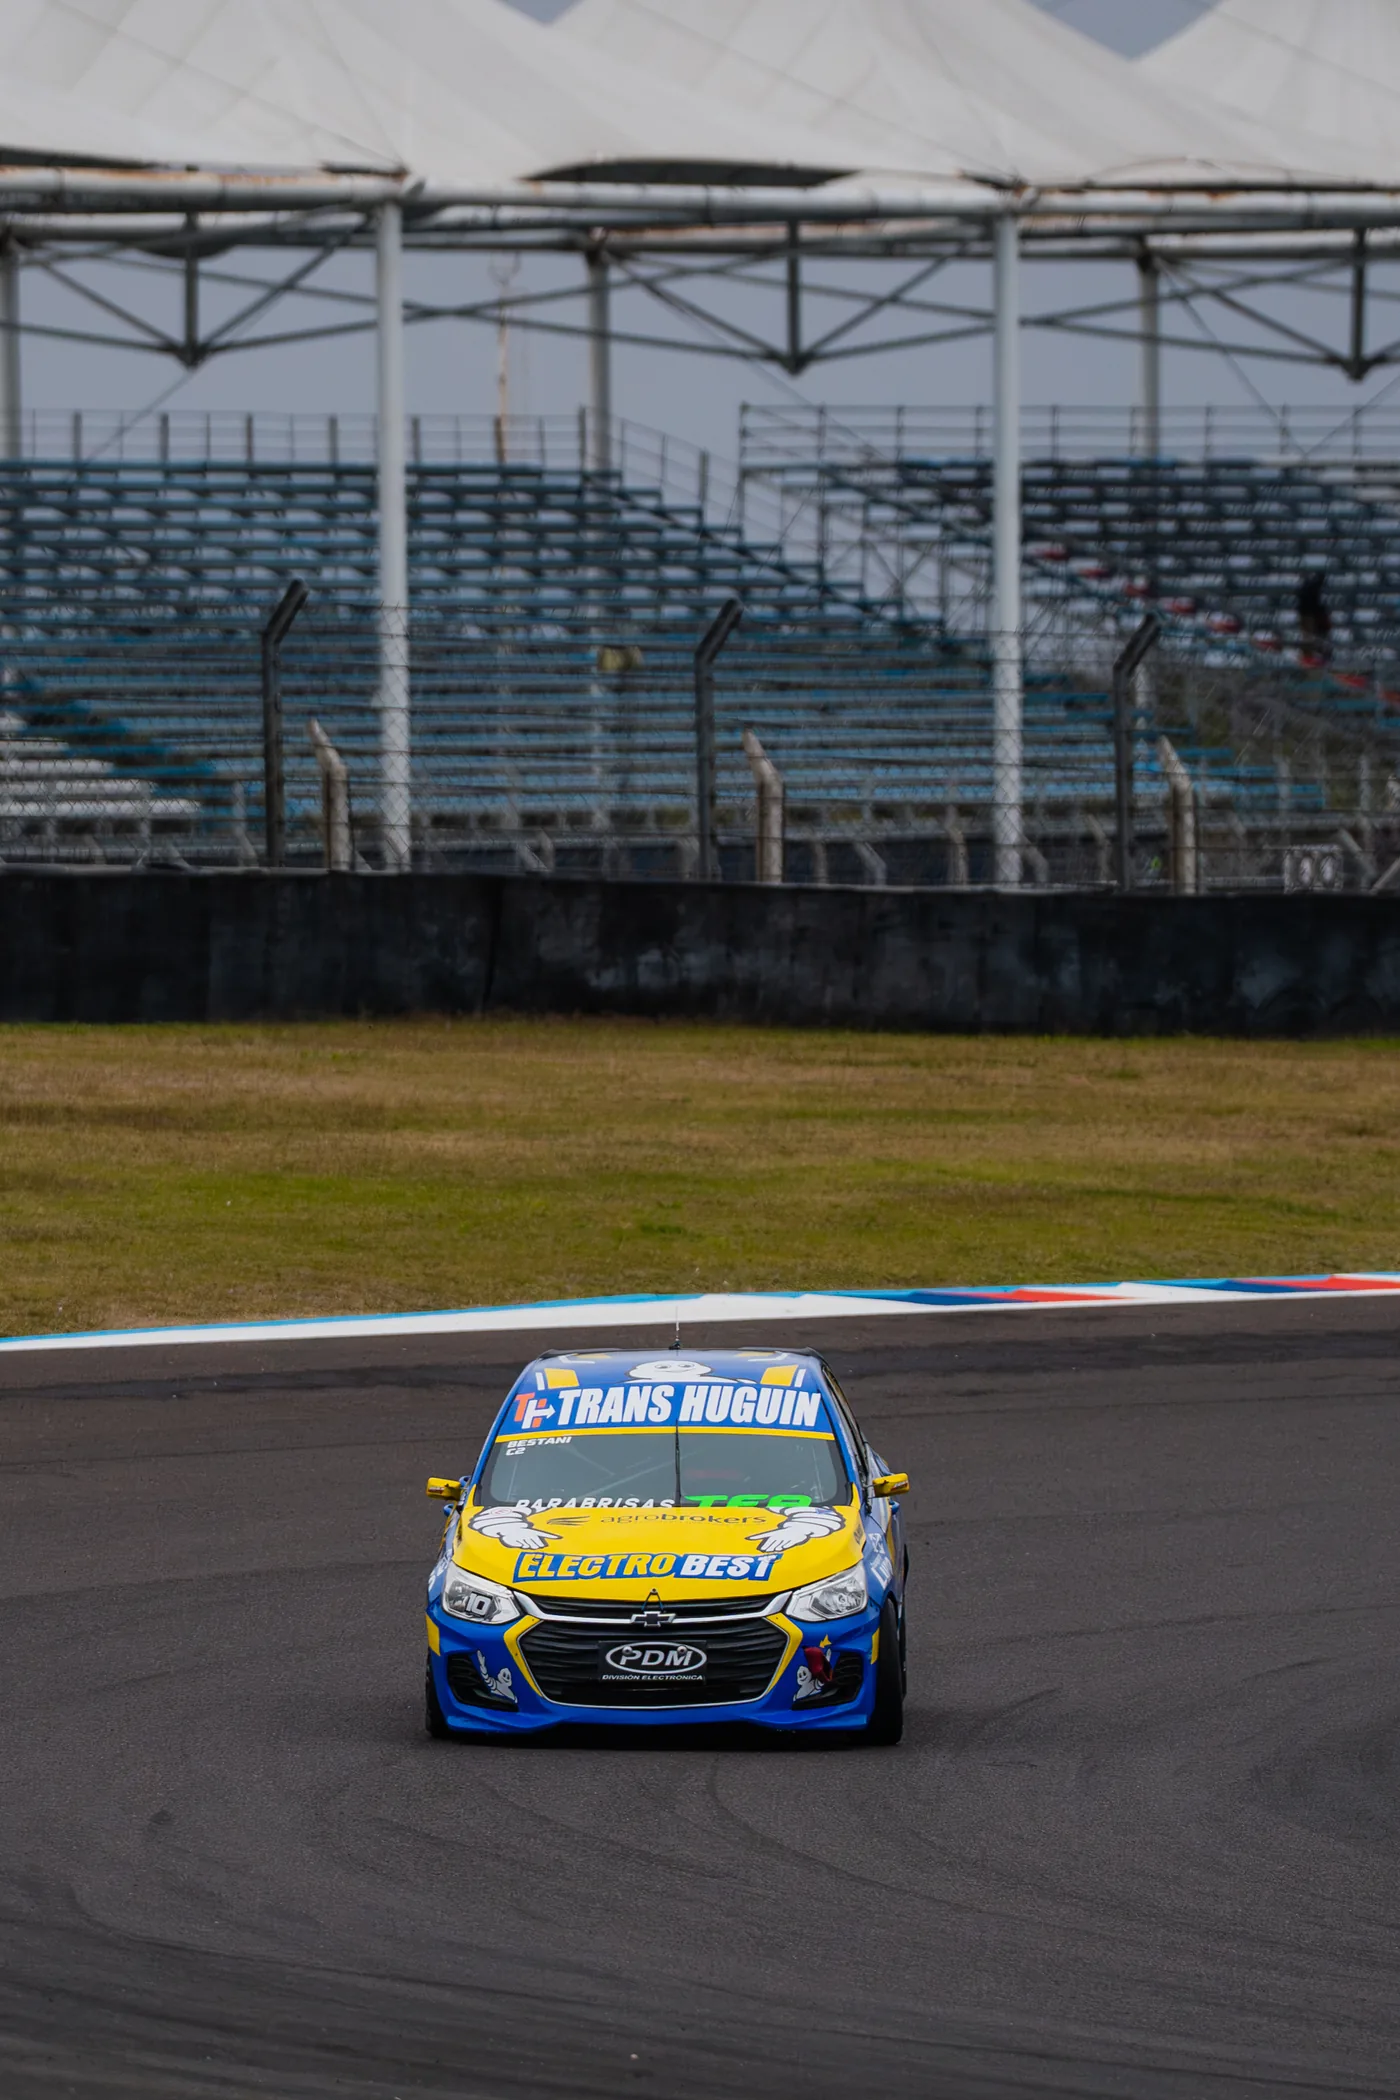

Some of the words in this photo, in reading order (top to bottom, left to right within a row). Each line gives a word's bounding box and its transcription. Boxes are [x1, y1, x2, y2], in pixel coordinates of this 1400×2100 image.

[557, 1385, 675, 1426] TRANS
[678, 1385, 822, 1427] HUGUIN
[507, 1436, 572, 1449] BESTANI
[600, 1513, 767, 1524] agrobrokers
[516, 1552, 677, 1579] ELECTRO
[679, 1553, 778, 1578] BEST
[466, 1592, 491, 1616] 10
[619, 1649, 693, 1666] PDM
